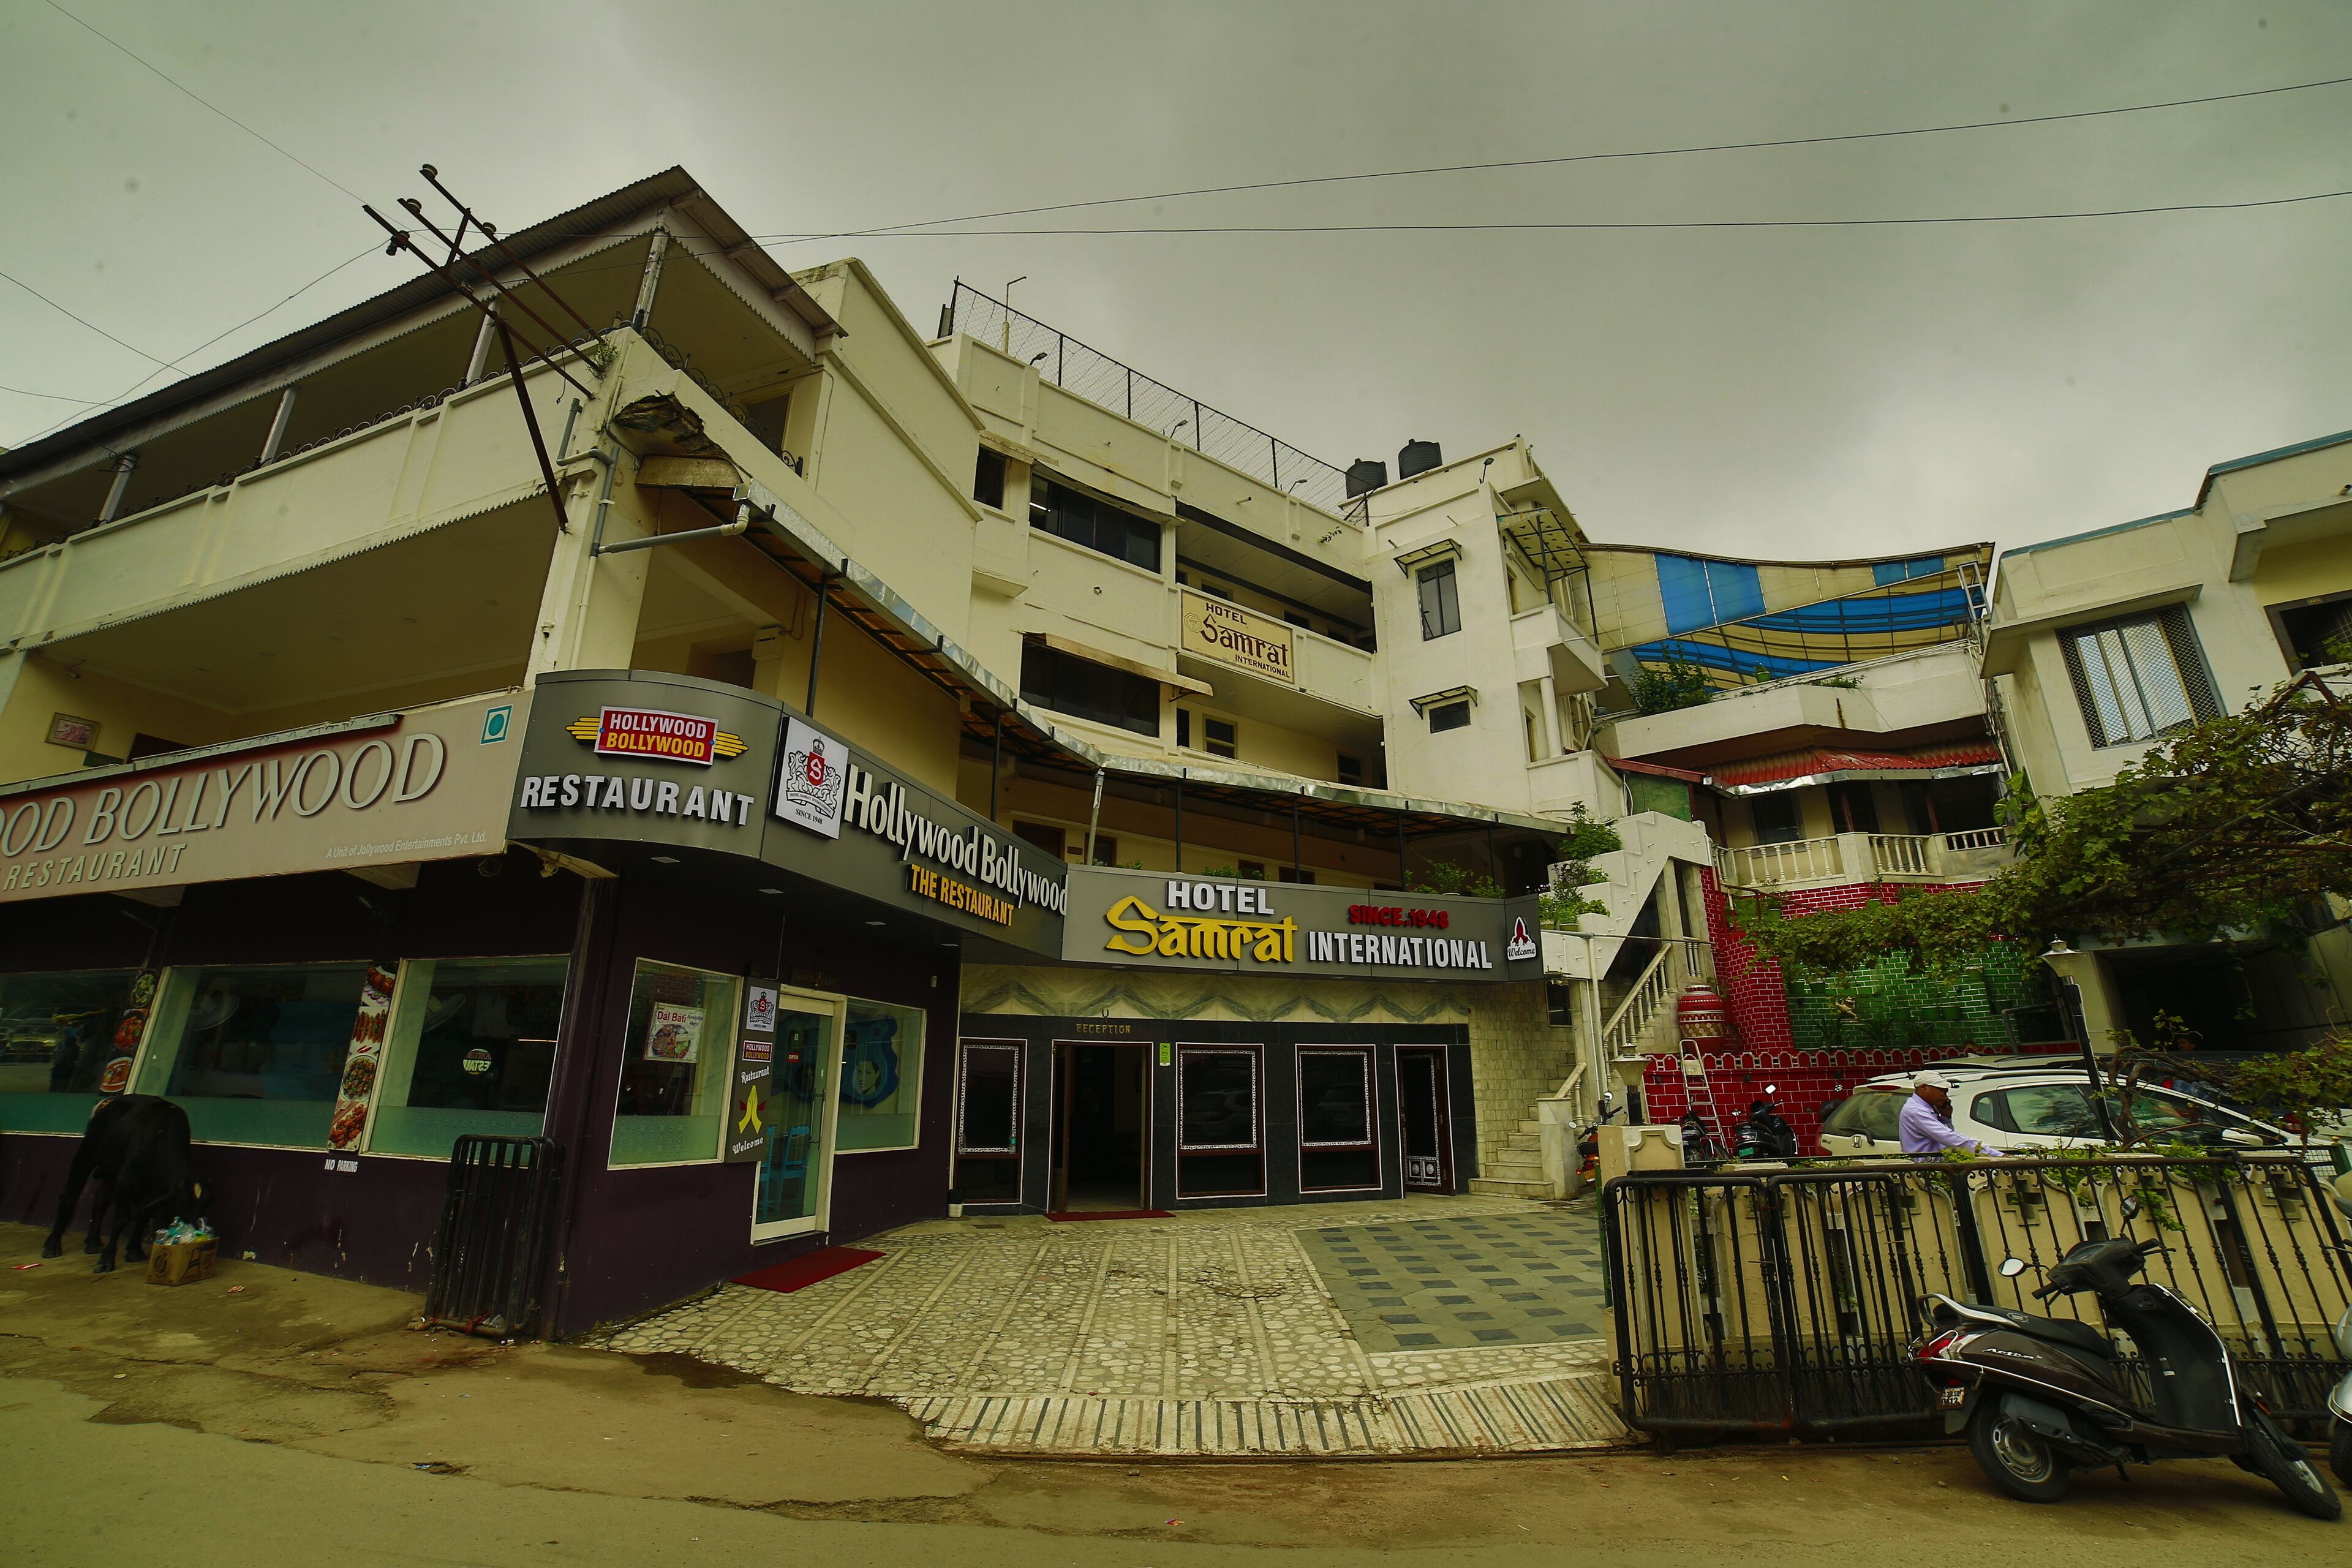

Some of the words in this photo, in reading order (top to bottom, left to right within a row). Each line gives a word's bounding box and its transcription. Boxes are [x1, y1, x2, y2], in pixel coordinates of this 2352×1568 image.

[1206, 602, 1246, 625] HOTEL
[1200, 614, 1288, 667] Samrat
[1235, 654, 1290, 678] INTERNATIONAL
[609, 714, 707, 739] HOLLYWOOD
[606, 733, 705, 758] BOLLYWOOD
[0, 797, 75, 857] OD
[83, 733, 445, 845] BOLLYWOOD
[520, 774, 755, 826] RESTAURANT
[796, 809, 812, 820] SINCE
[812, 815, 823, 824] 1948
[326, 848, 332, 858] A
[333, 846, 347, 857] Unit
[349, 845, 357, 856] of
[395, 835, 452, 851] Entertainments
[453, 833, 469, 845] Pvt.
[471, 830, 487, 844] Ltd.
[844, 763, 979, 876] Hollywood
[981, 834, 1068, 916] Bollywood
[3, 843, 187, 891] RESTAURANT
[911, 864, 938, 899] THE
[940, 876, 1014, 927] RESTAURANT
[1167, 881, 1274, 914] HOTEL
[1105, 895, 1298, 962] Samrat
[1308, 930, 1493, 969] INTERNATIONAL
[1507, 946, 1536, 958] Welcome
[657, 1011, 669, 1021] Dal
[672, 1012, 687, 1023] Bati
[1076, 1023, 1131, 1034] RECEPTION
[745, 1051, 769, 1060] BOLLYWOOD
[741, 1066, 770, 1084] Restaurant
[732, 1137, 764, 1155] Welcome
[325, 1159, 336, 1170] NO
[336, 1159, 358, 1173] PARKING
